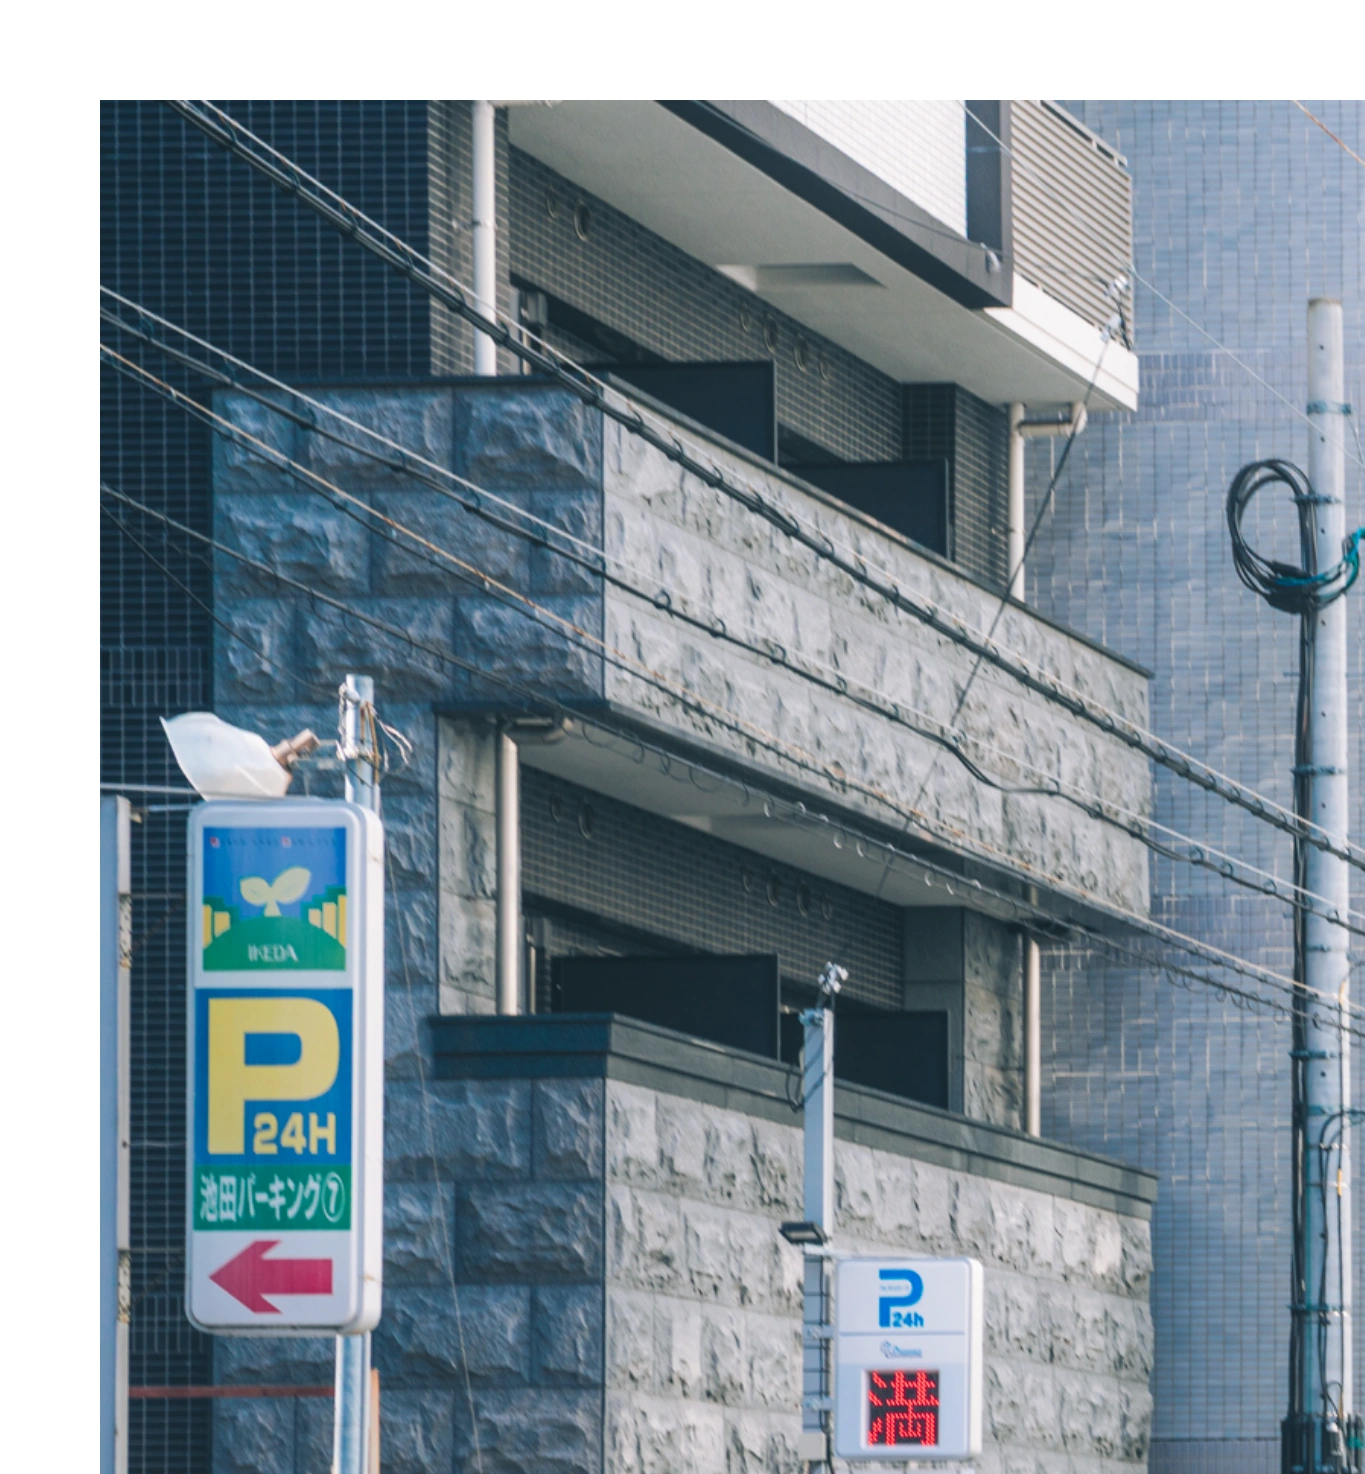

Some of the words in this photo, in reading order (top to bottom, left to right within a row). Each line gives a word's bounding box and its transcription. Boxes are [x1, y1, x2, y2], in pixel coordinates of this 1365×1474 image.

[248, 943, 298, 962] IKEDA
[208, 998, 340, 1154] P
[252, 1113, 337, 1155] 24H
[879, 1268, 924, 1328] P
[892, 1311, 925, 1328] 24h
[867, 1370, 940, 1447] 満
